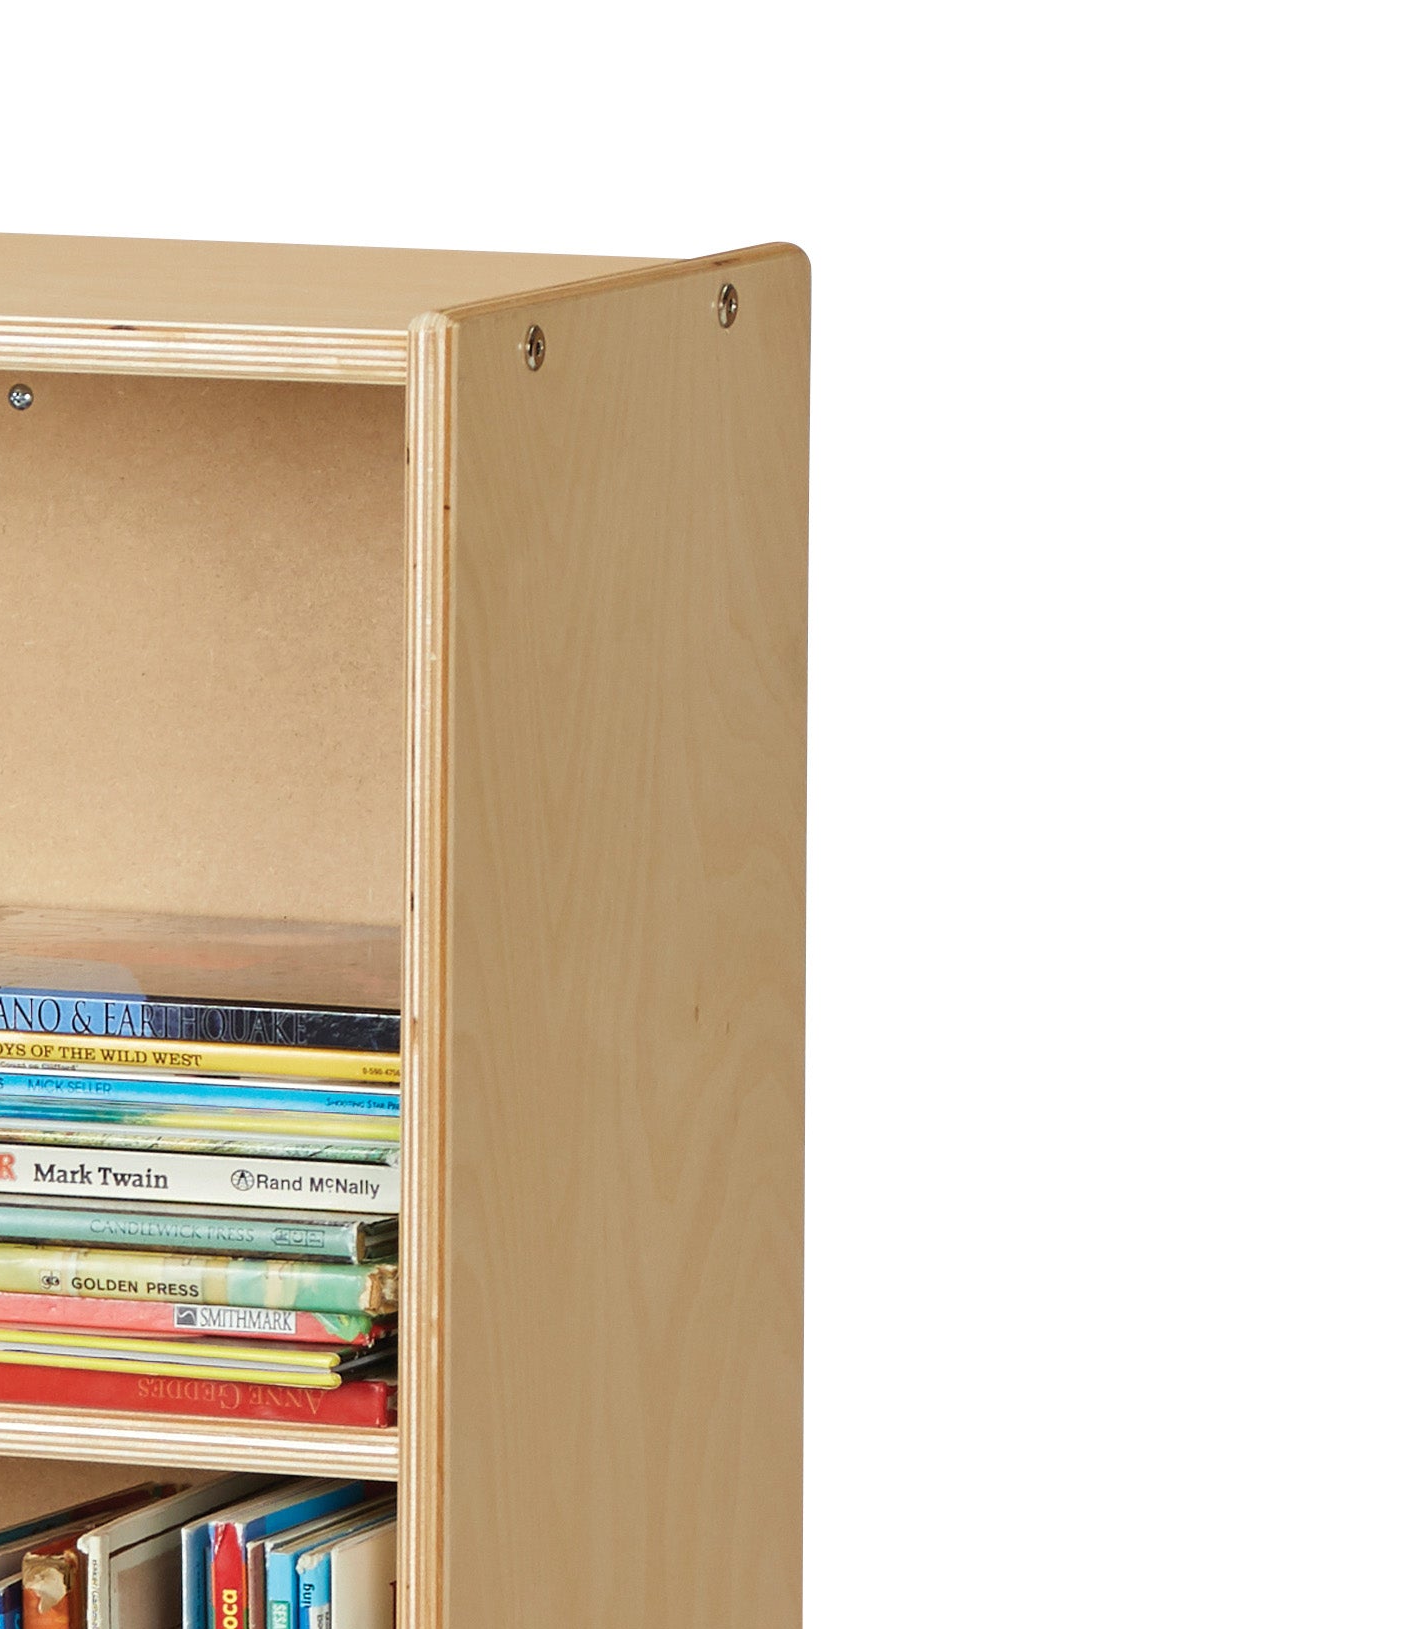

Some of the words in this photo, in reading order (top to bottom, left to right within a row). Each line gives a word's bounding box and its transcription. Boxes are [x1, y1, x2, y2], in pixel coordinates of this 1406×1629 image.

[104, 1002, 307, 1046] EARTHQUAKE
[100, 1048, 148, 1065] WILD
[33, 1163, 93, 1186] Mark
[98, 1167, 168, 1191] Twain
[255, 1173, 303, 1192] Rand
[309, 1177, 380, 1198] McNally
[90, 1218, 198, 1239] CANDLEWICK
[71, 1277, 139, 1294] GOLDEN
[146, 1280, 199, 1297] PRESS
[199, 1306, 293, 1332] SMITHMARK
[138, 1378, 242, 1409] GEDDES
